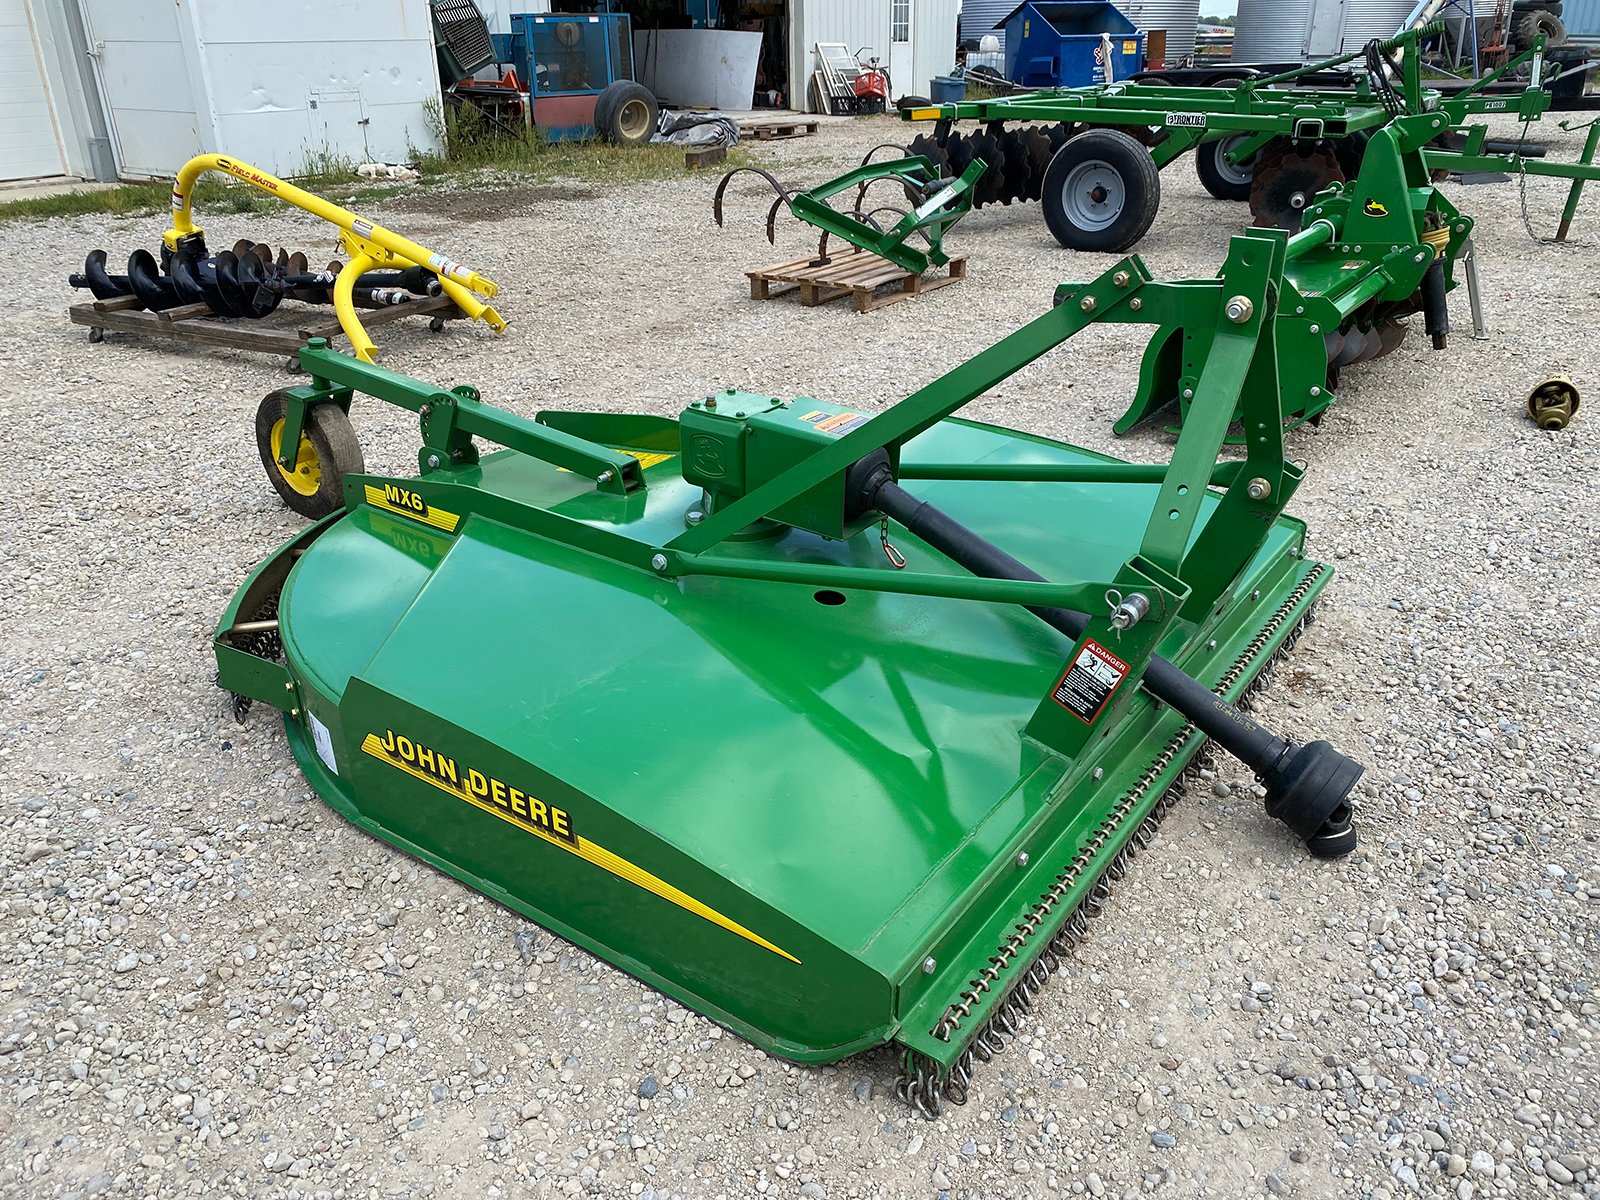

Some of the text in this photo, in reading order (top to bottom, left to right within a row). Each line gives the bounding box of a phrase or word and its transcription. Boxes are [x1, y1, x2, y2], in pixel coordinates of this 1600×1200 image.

[1174, 114, 1206, 126] FRONTIER
[250, 173, 278, 191] MASTER
[384, 483, 424, 511] MX6
[1095, 646, 1126, 671] DANGER
[380, 729, 458, 783] JOHN
[468, 767, 570, 837] DEERE
